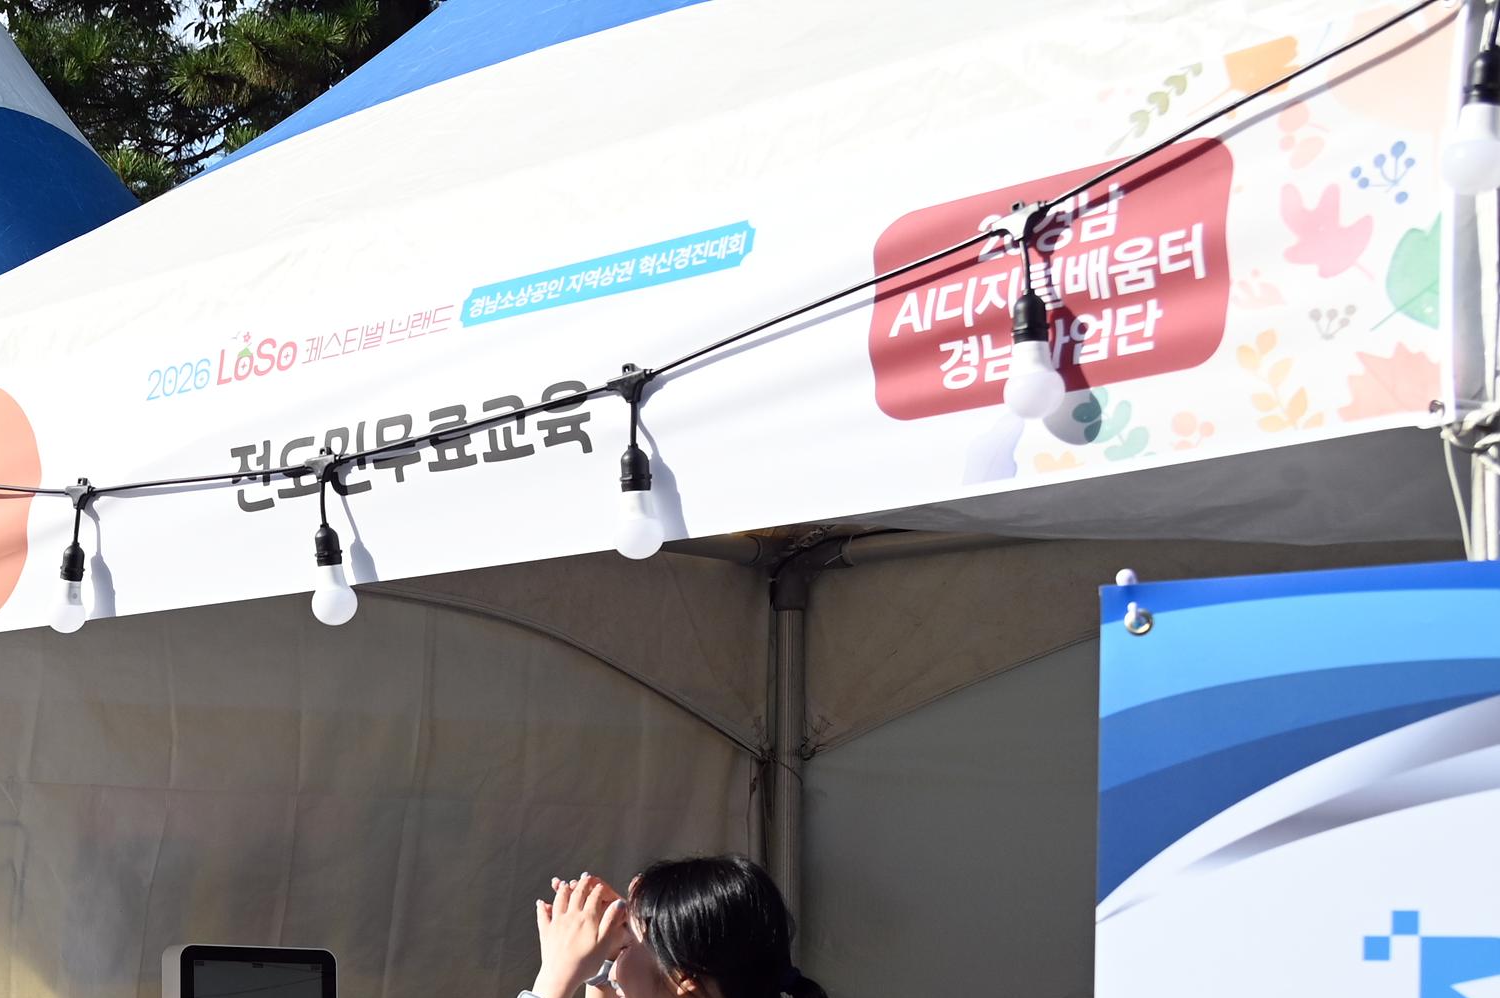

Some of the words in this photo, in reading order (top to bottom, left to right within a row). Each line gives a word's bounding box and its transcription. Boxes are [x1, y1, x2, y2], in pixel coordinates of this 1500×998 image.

[469, 278, 565, 319] 경남소상공인
[566, 263, 635, 296] 지역상권
[637, 228, 748, 278] 혁신경진대회
[889, 221, 1211, 338] AI디지털배움터
[146, 358, 212, 402] 2026
[301, 321, 385, 366] 페스티벌
[389, 304, 455, 344] 브랜드
[229, 378, 595, 514] 전도민무료교육
